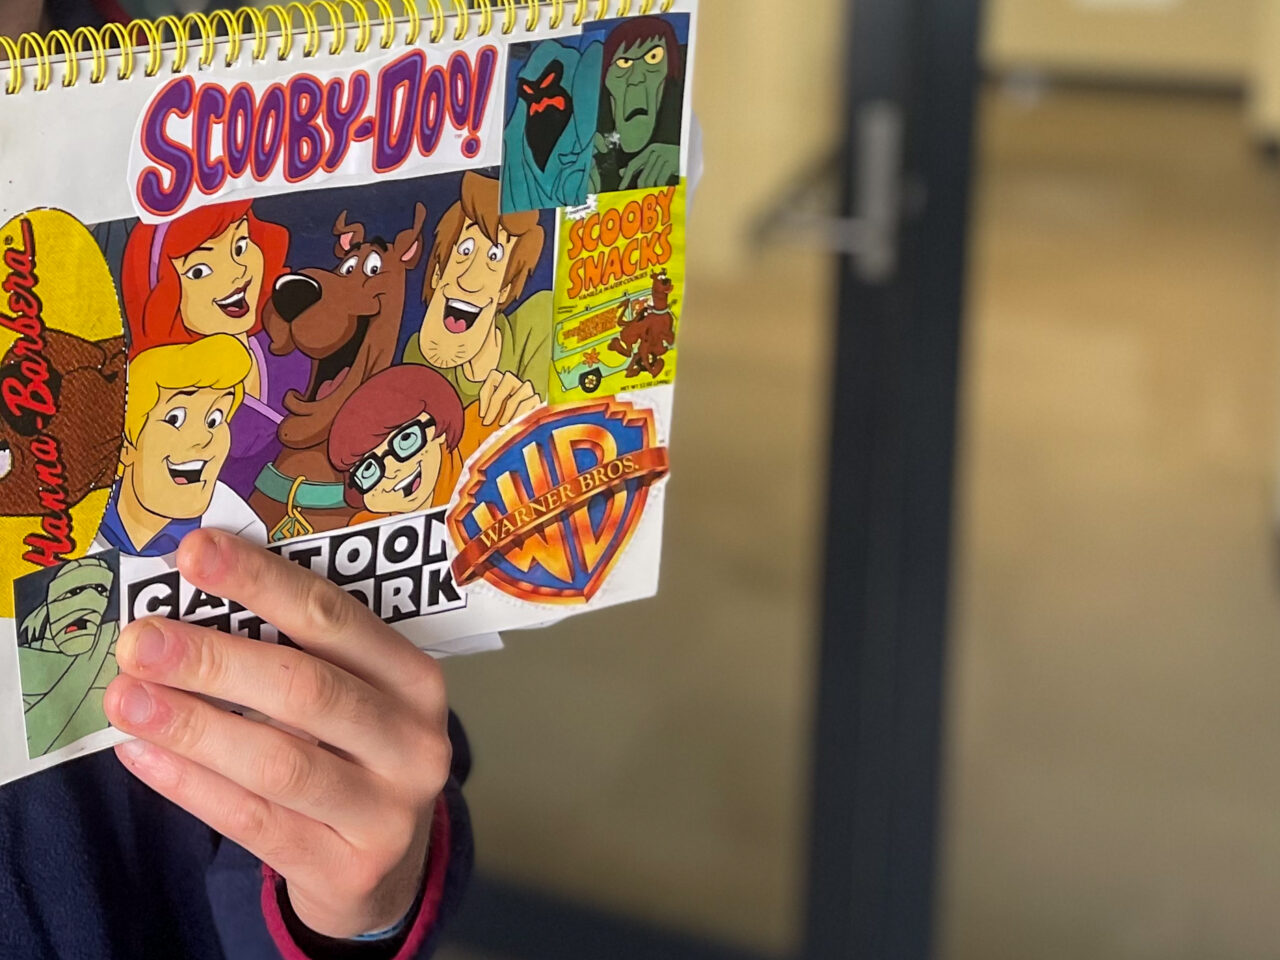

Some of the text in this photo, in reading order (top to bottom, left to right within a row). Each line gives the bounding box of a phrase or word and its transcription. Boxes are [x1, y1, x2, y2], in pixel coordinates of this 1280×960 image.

[137, 45, 497, 216] SCOOBY-DOO!
[567, 223, 672, 299] SNACKS
[568, 185, 676, 260] SCOOBY
[480, 456, 640, 548] WARNER BROS.
[132, 517, 448, 621] CATOO
